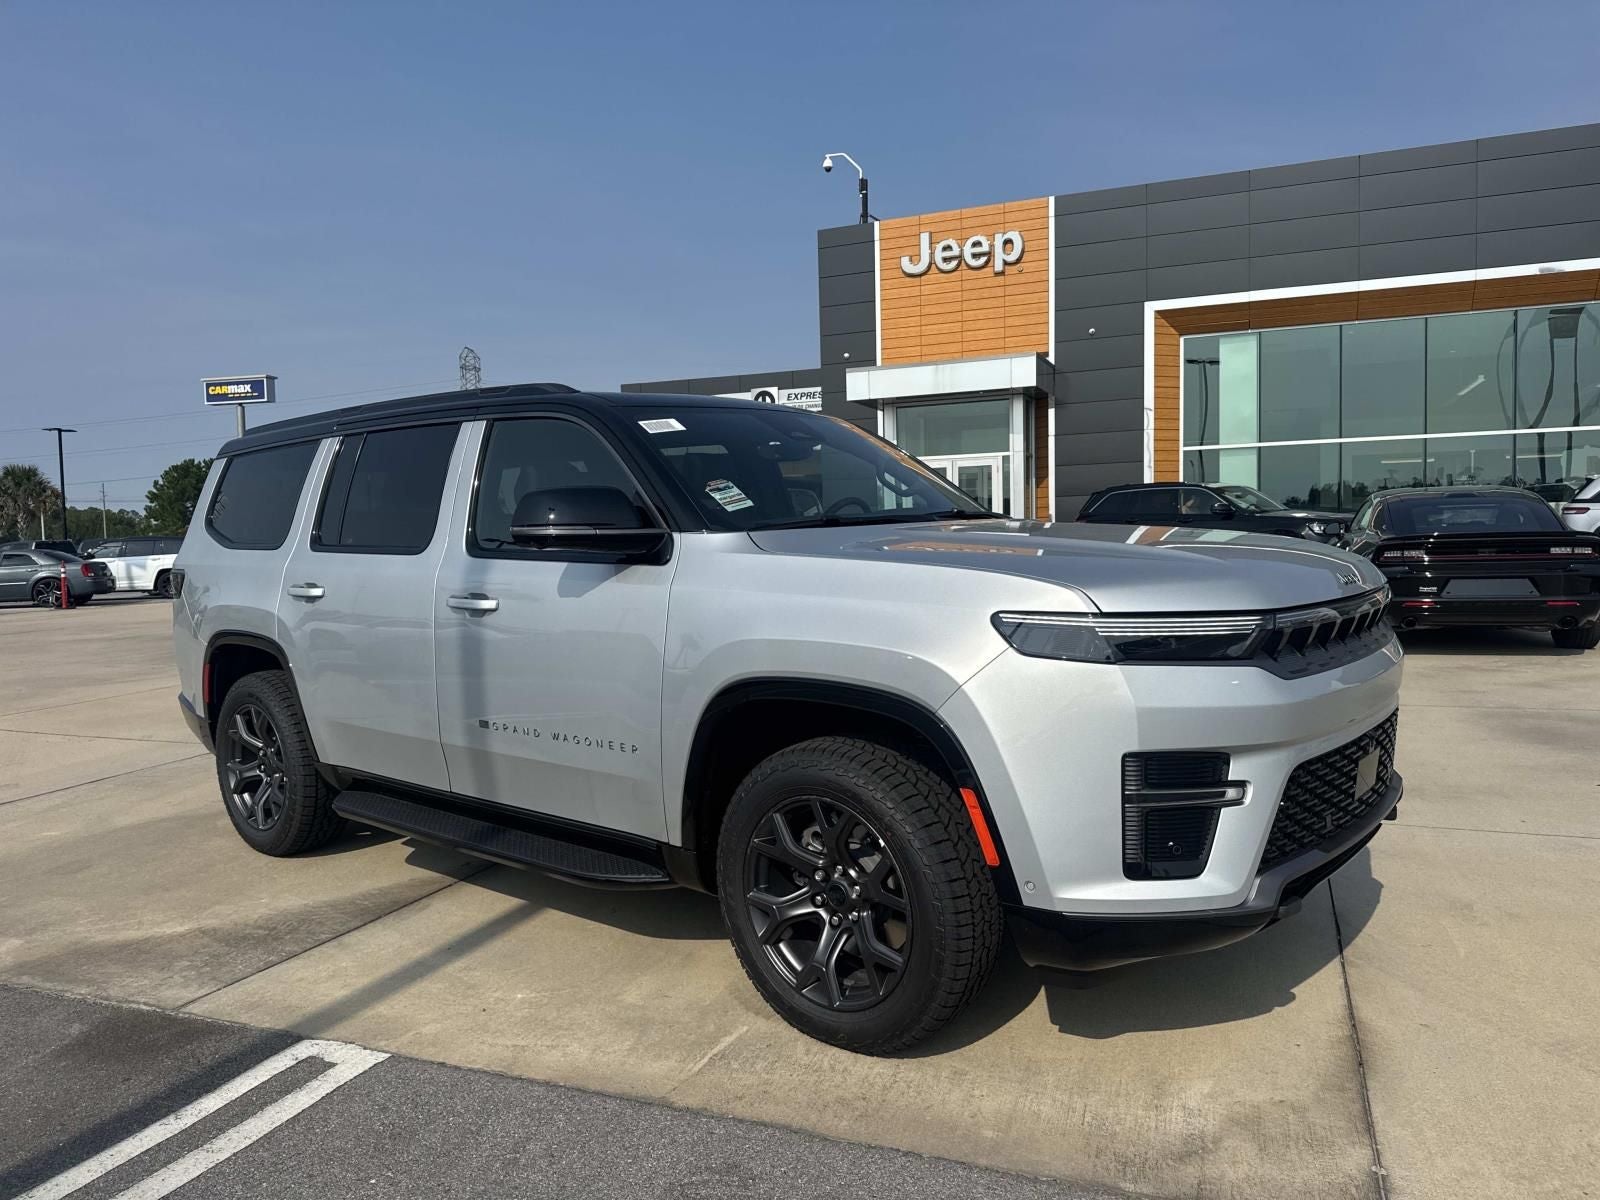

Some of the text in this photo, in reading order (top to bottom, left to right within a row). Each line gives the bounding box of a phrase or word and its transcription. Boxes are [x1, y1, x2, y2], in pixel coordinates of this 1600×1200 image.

[900, 230, 1025, 276] Jeep
[492, 721, 639, 753] GRAND WAGONEER
